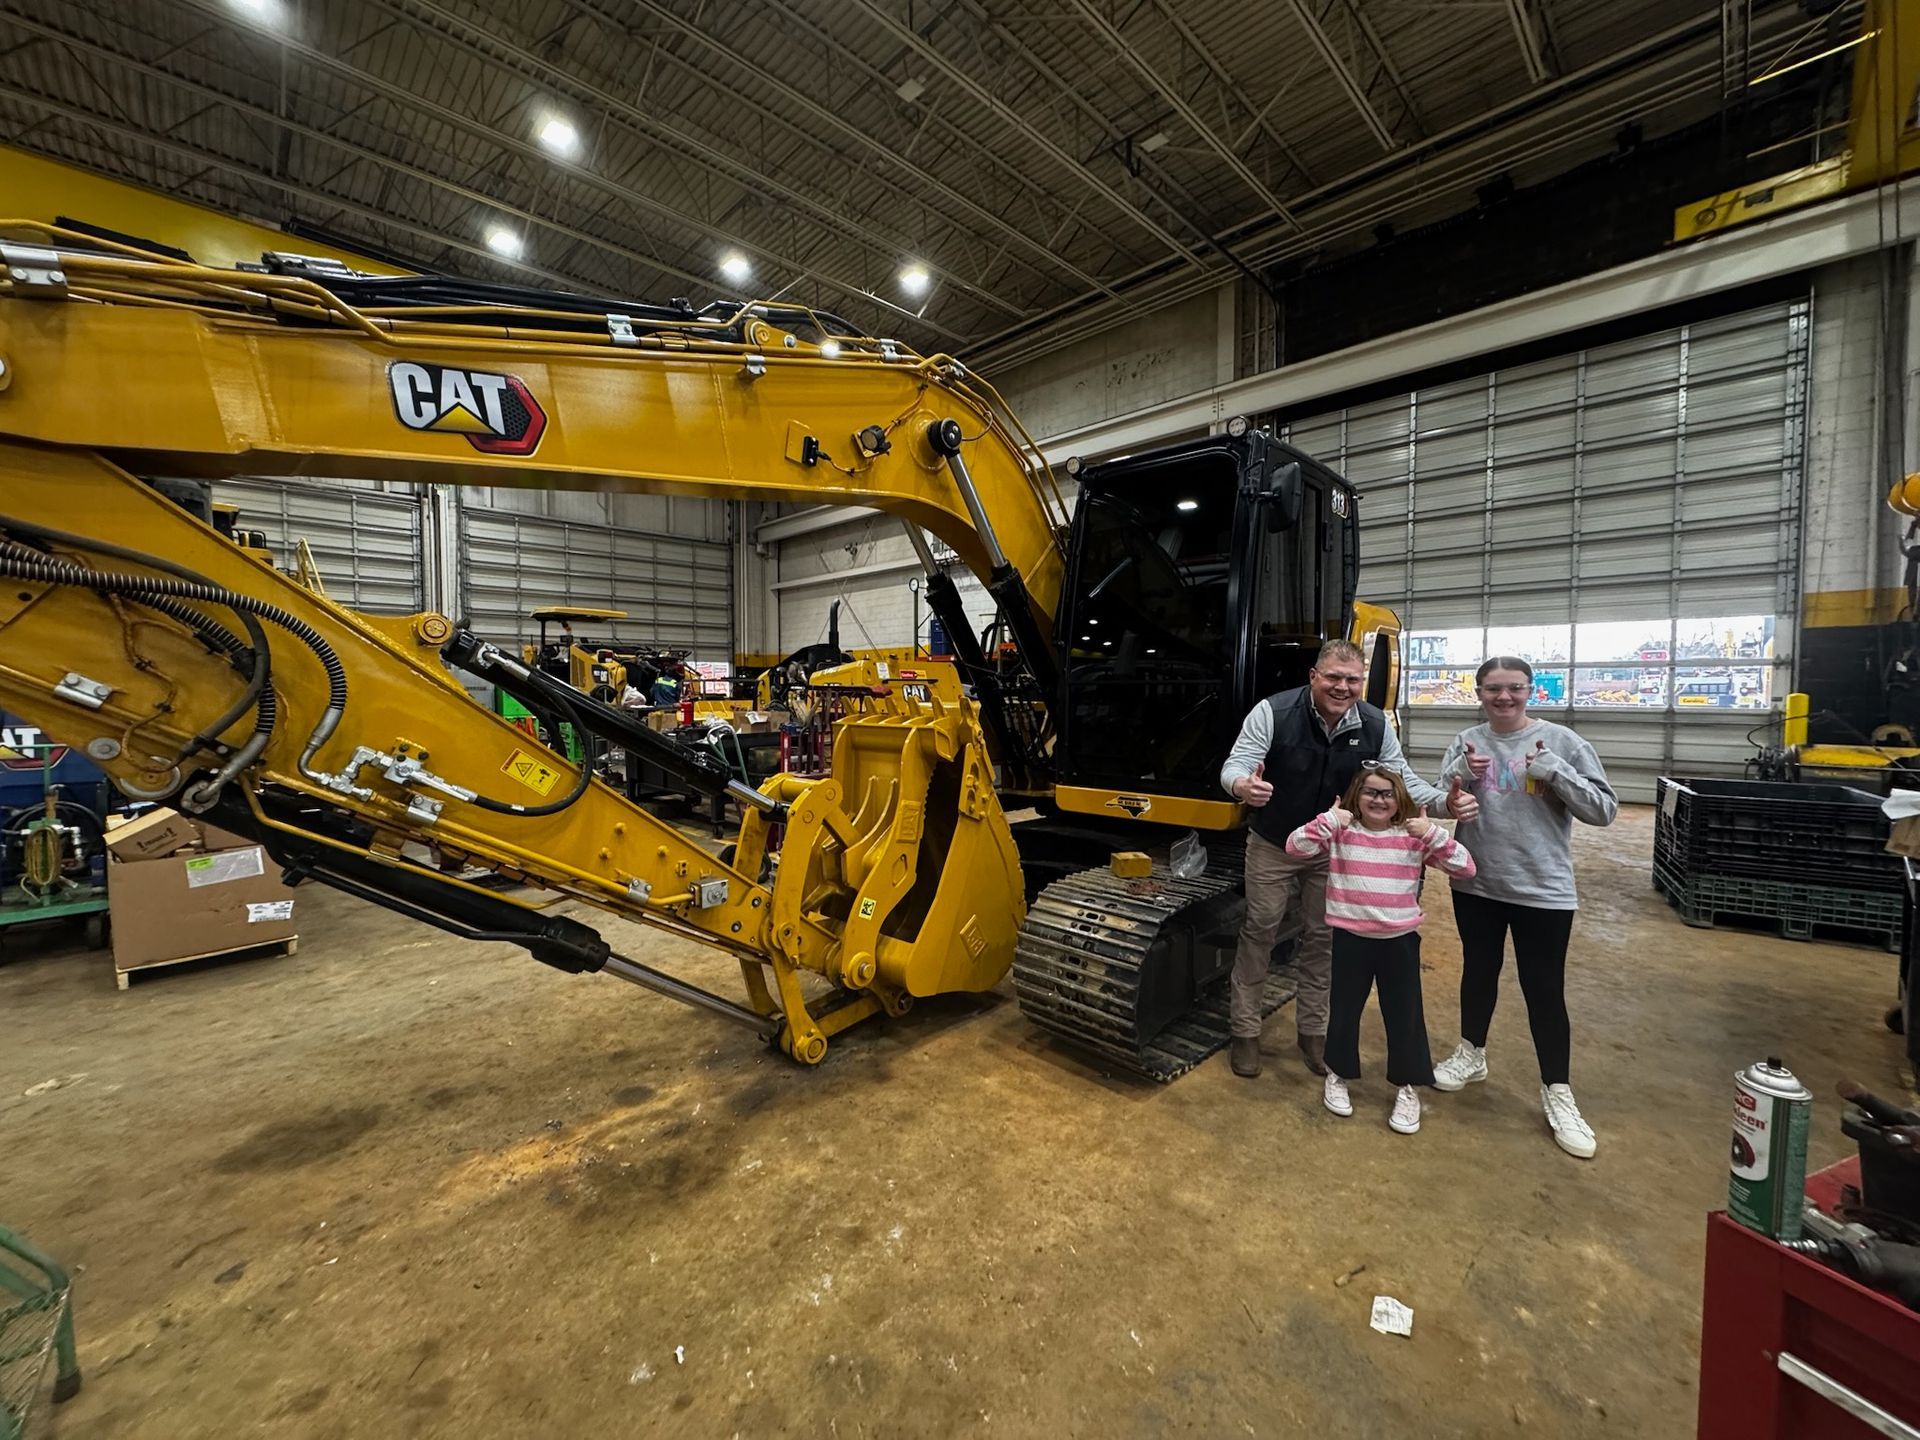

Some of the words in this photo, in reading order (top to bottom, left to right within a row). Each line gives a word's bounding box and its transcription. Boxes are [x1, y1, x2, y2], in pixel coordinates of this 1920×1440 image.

[391, 362, 507, 436] CAT
[1331, 488, 1345, 515] 313
[1, 728, 41, 758] AT
